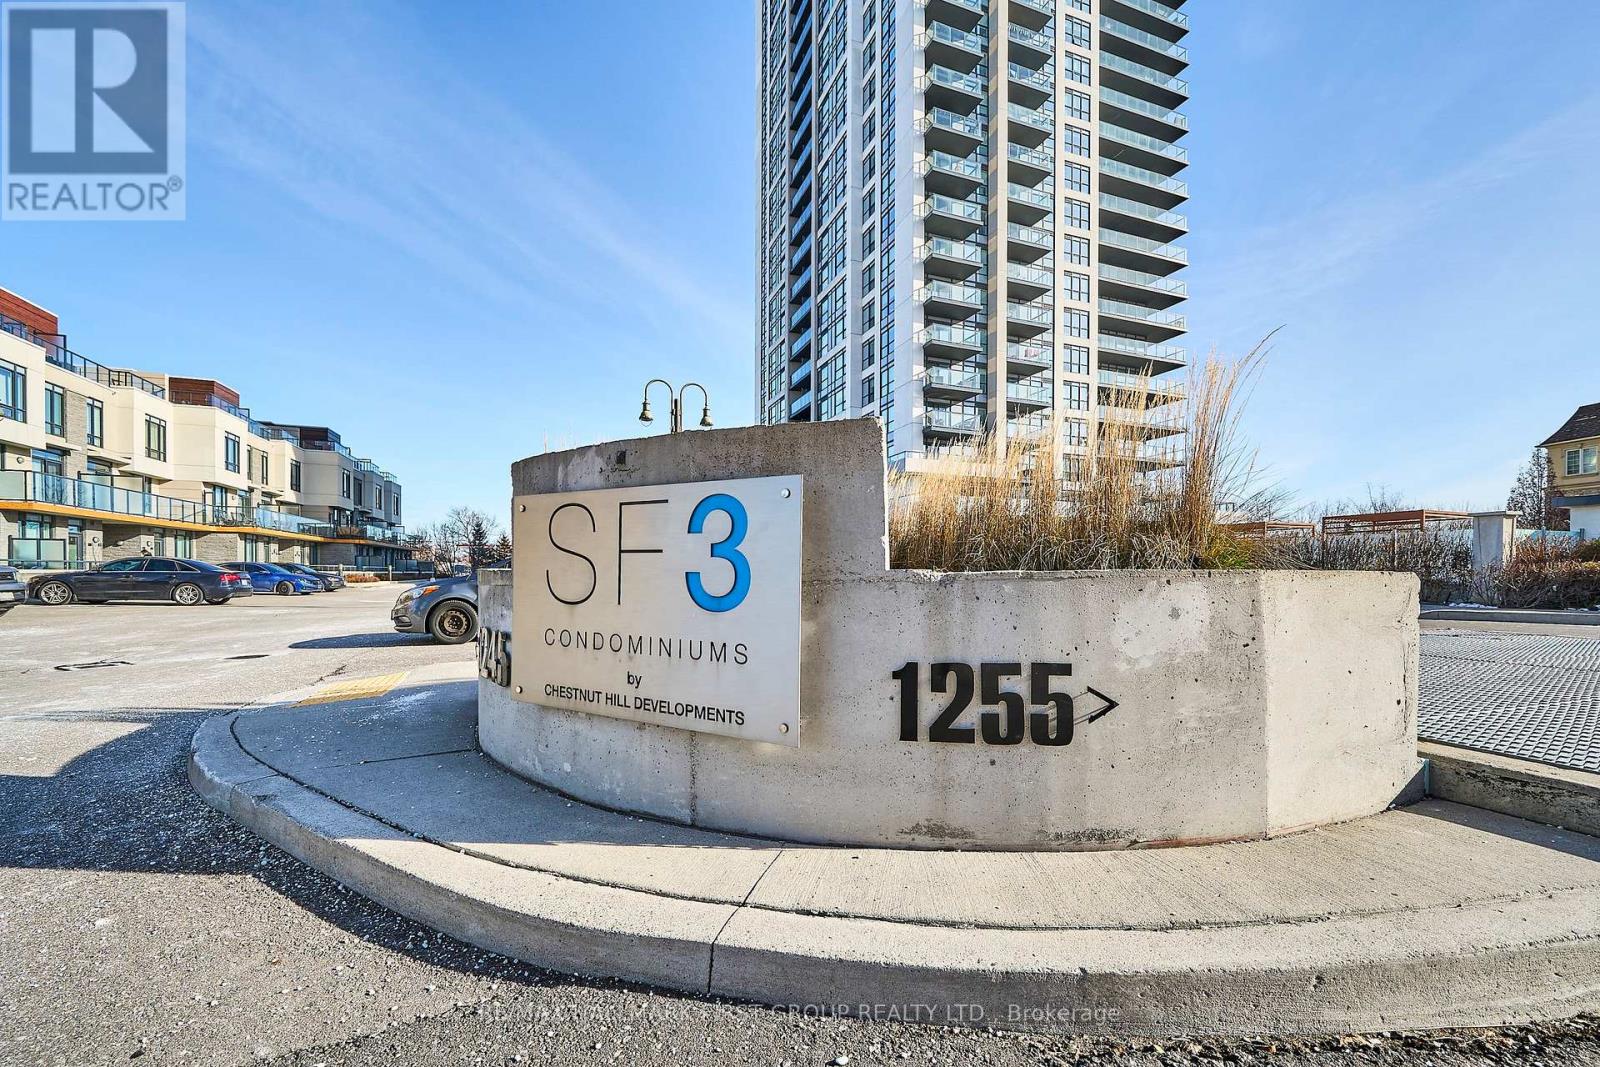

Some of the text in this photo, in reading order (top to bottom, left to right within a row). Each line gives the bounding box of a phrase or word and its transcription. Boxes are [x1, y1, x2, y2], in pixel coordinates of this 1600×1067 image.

[544, 628, 748, 665] CONDOMINIUMS
[627, 671, 642, 688] by
[544, 684, 745, 725] CHESTNUT HILL DEVELOPMENTS
[892, 661, 1074, 746] 1255
